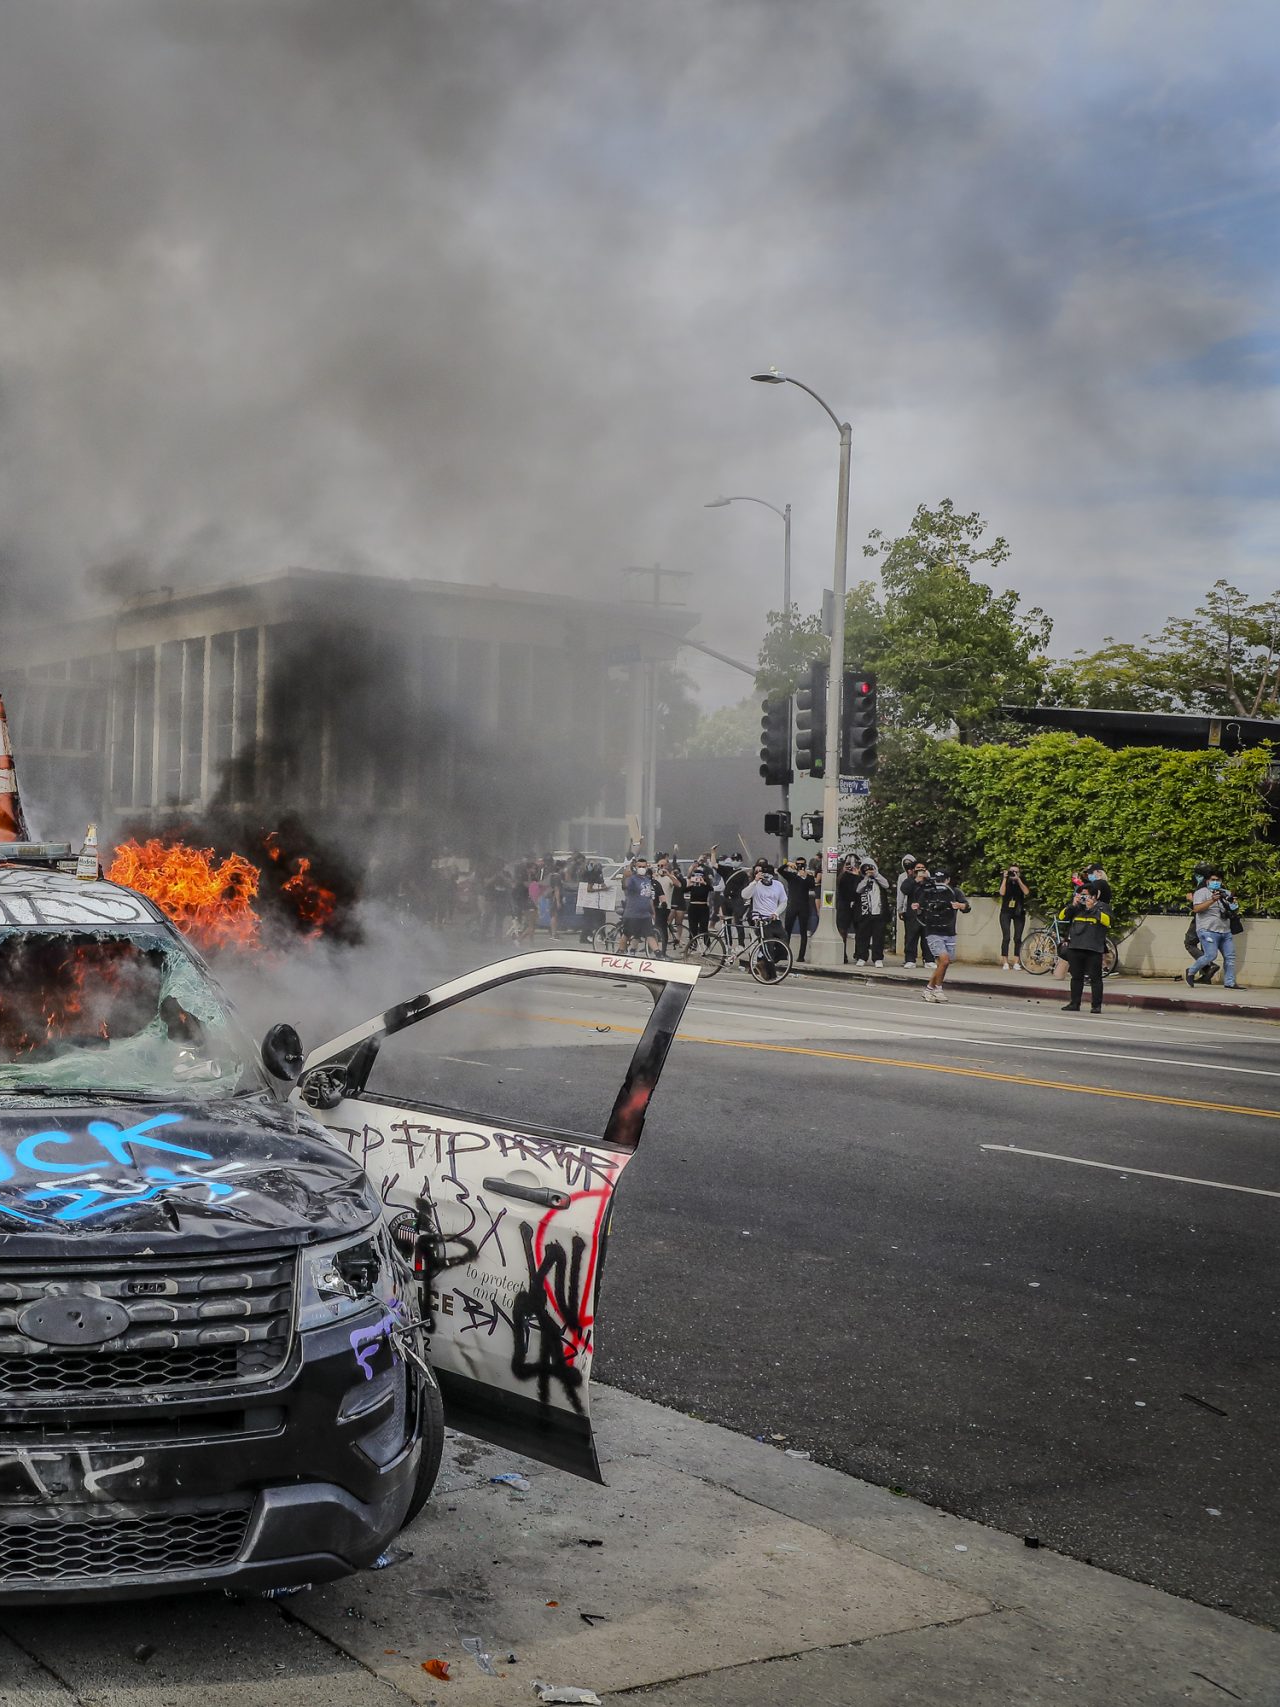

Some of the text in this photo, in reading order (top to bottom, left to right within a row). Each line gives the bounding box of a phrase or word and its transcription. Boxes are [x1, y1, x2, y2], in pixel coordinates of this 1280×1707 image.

[601, 957, 655, 974] FUCK 12
[390, 1119, 491, 1180] FTP
[466, 1263, 478, 1280] to
[472, 1286, 499, 1302] and
[502, 1293, 514, 1309] to
